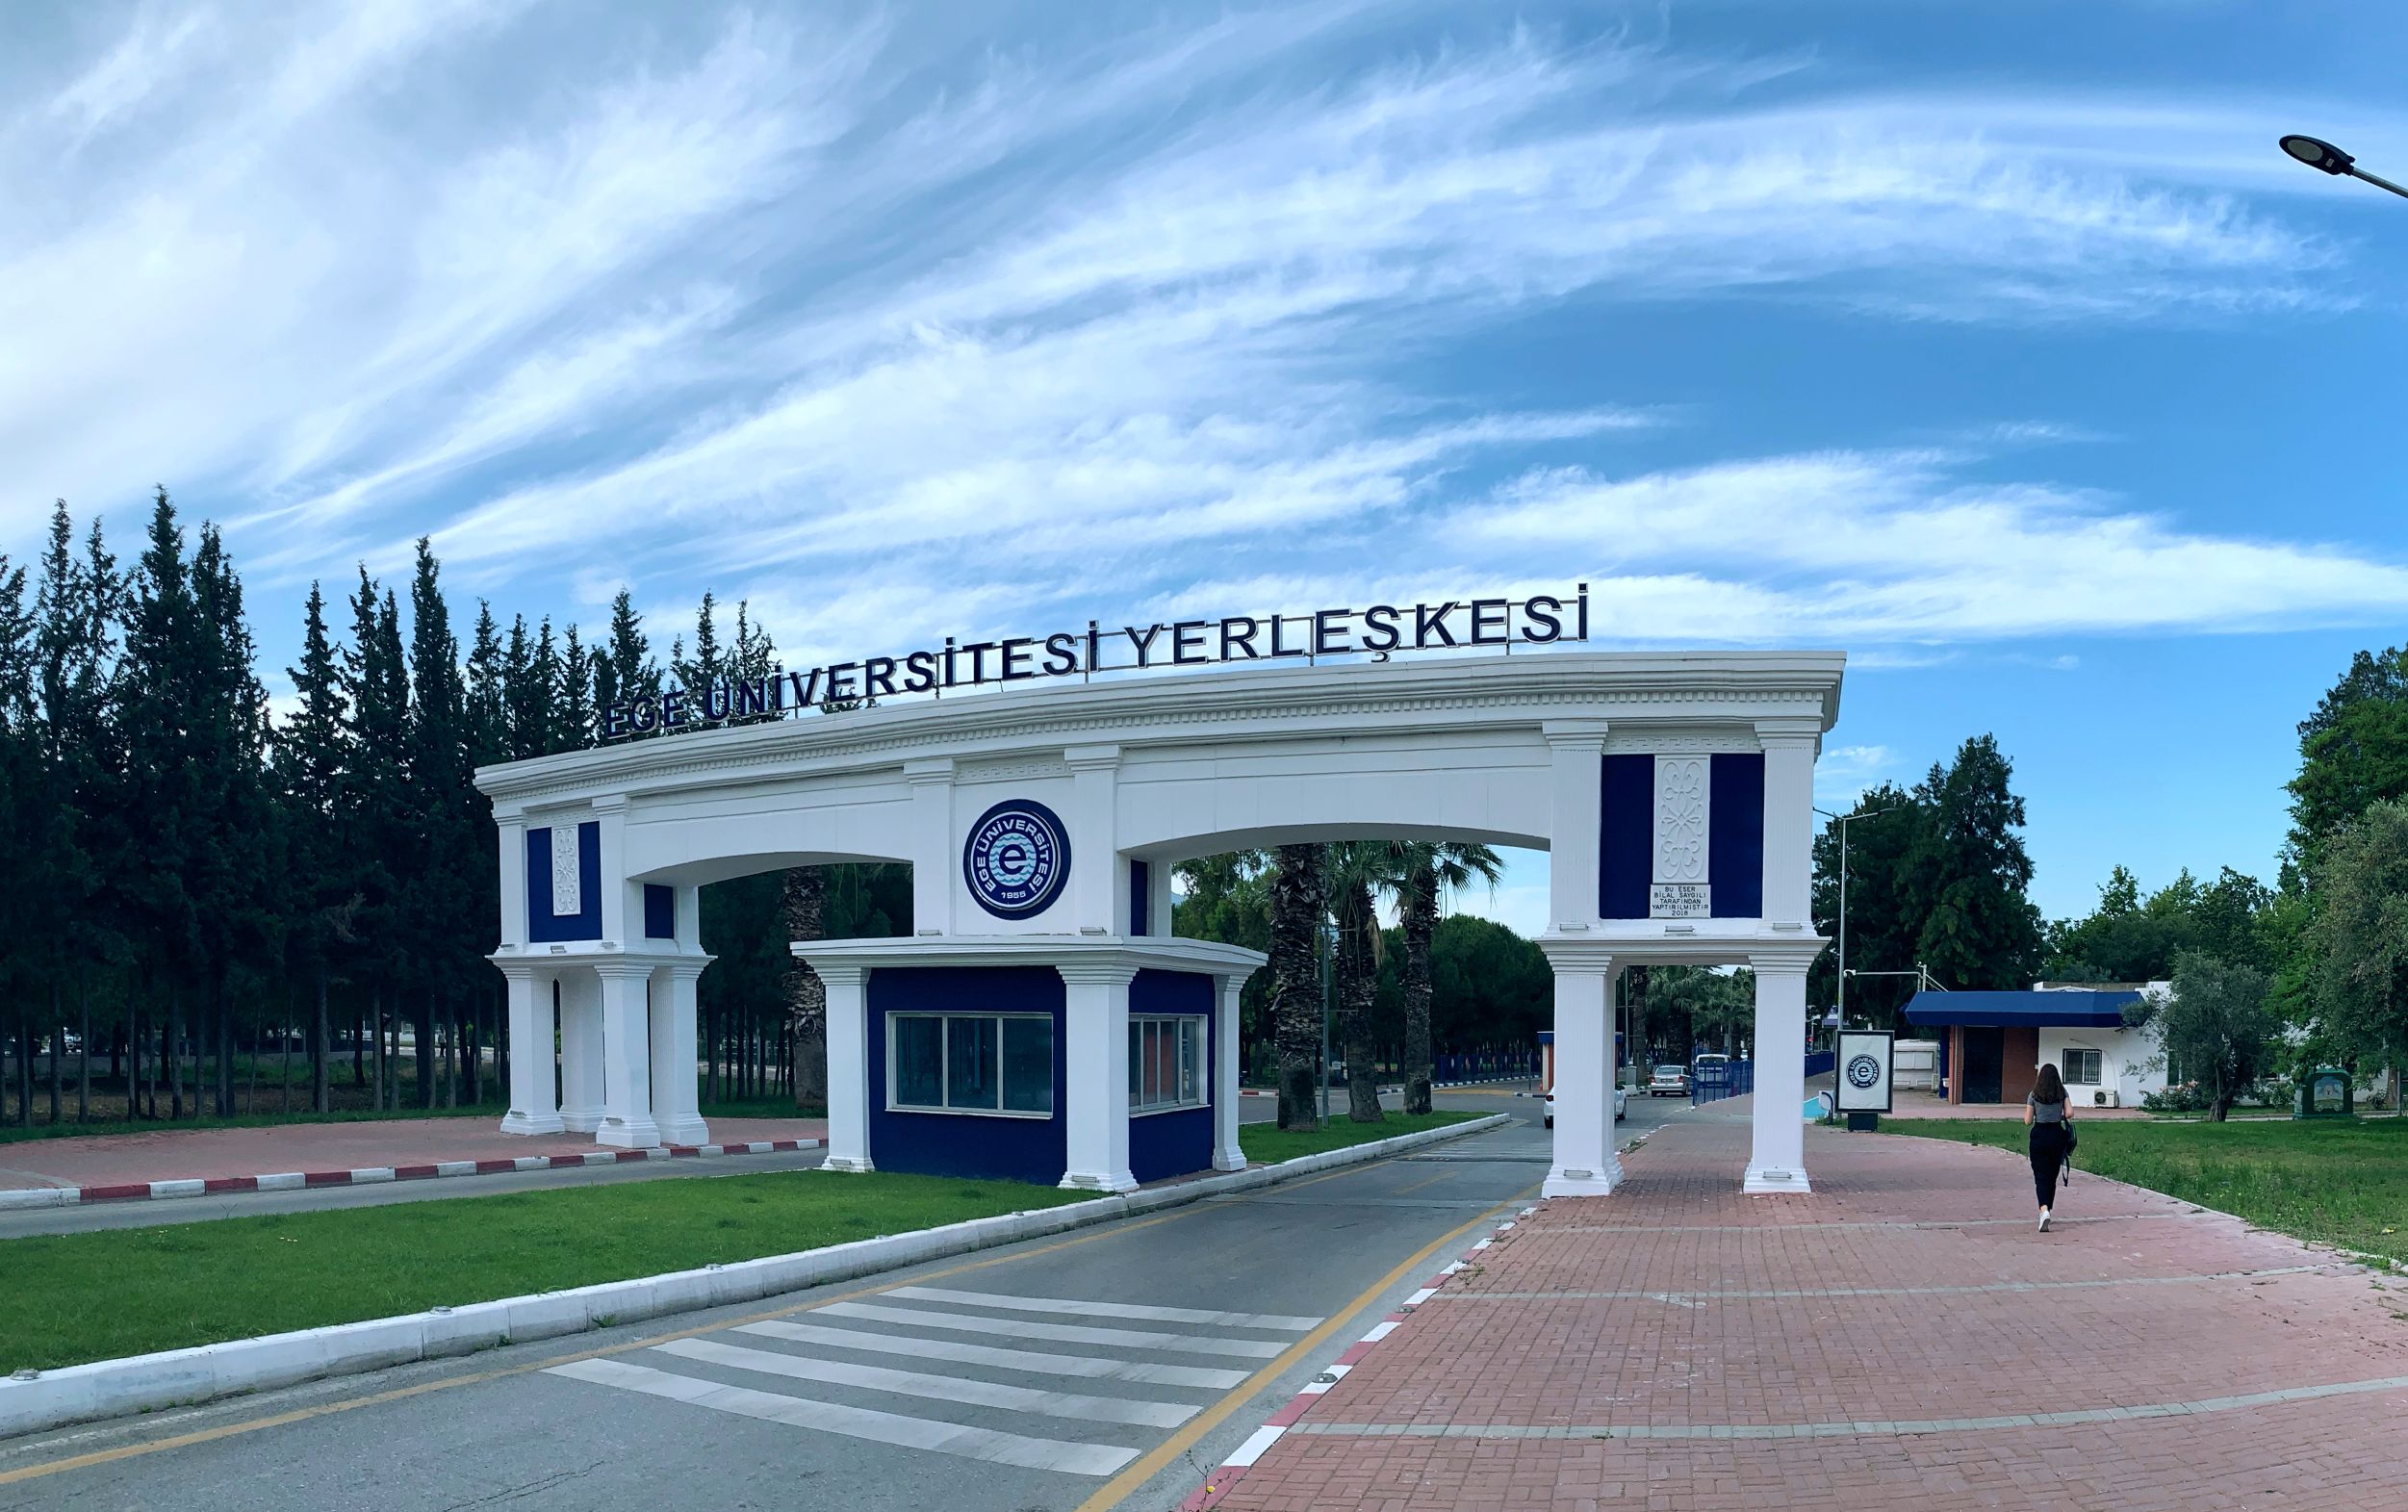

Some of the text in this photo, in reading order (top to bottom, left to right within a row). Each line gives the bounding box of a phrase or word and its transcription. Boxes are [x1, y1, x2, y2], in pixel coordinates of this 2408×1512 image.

[605, 583, 1590, 739] EGE ÜNİVERSİTESİ YERLEŞKESİ
[977, 857, 996, 892] EGE
[1001, 890, 1026, 899] 1955
